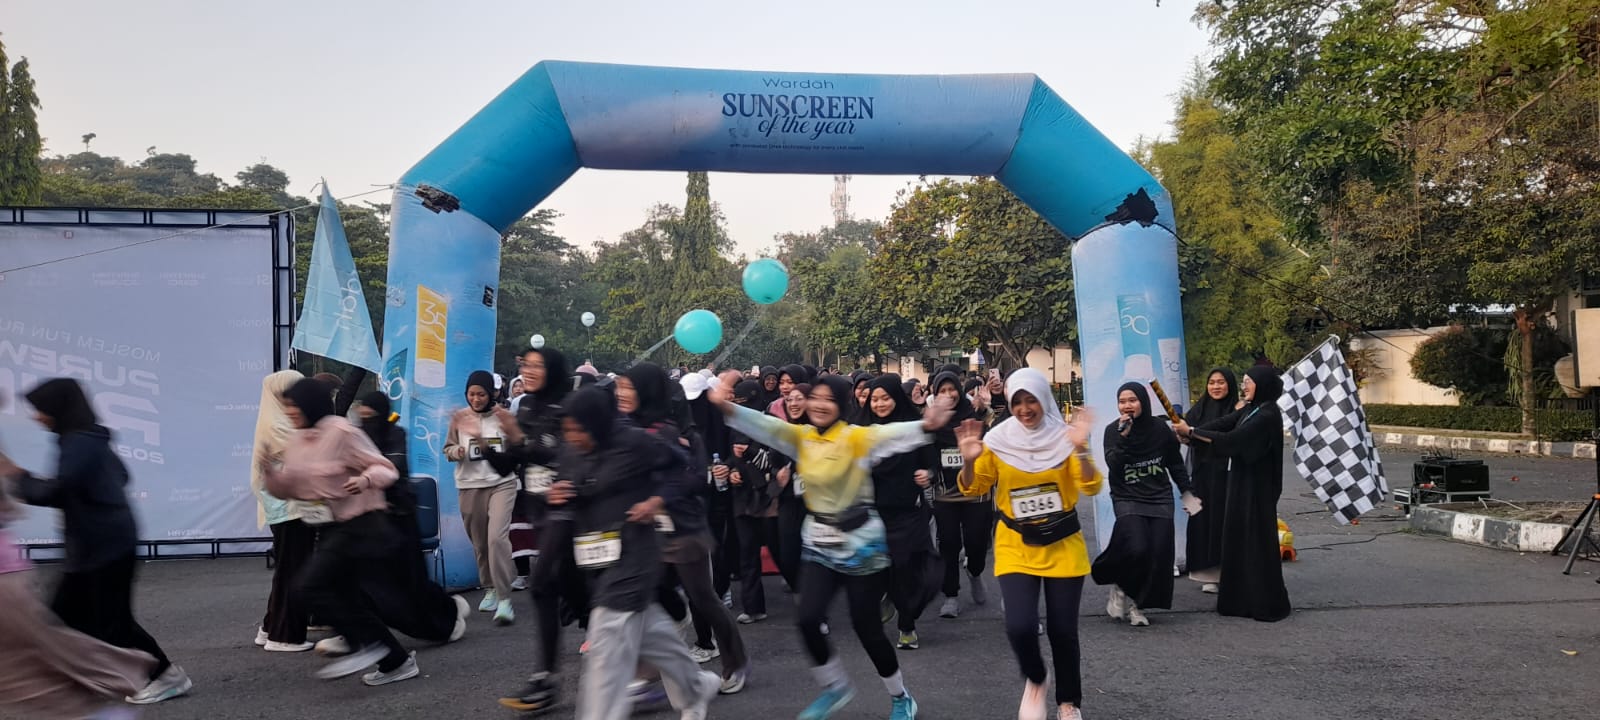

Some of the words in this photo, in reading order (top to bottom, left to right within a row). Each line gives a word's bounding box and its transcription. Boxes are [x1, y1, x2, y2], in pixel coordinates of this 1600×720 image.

[762, 77, 834, 91] Wardah
[722, 92, 875, 120] SUNSCREEN
[758, 113, 779, 137] of
[781, 114, 810, 133] the
[809, 119, 857, 140] year
[1120, 307, 1150, 336] 50
[947, 455, 963, 465] 031
[1019, 496, 1055, 514] 0366
